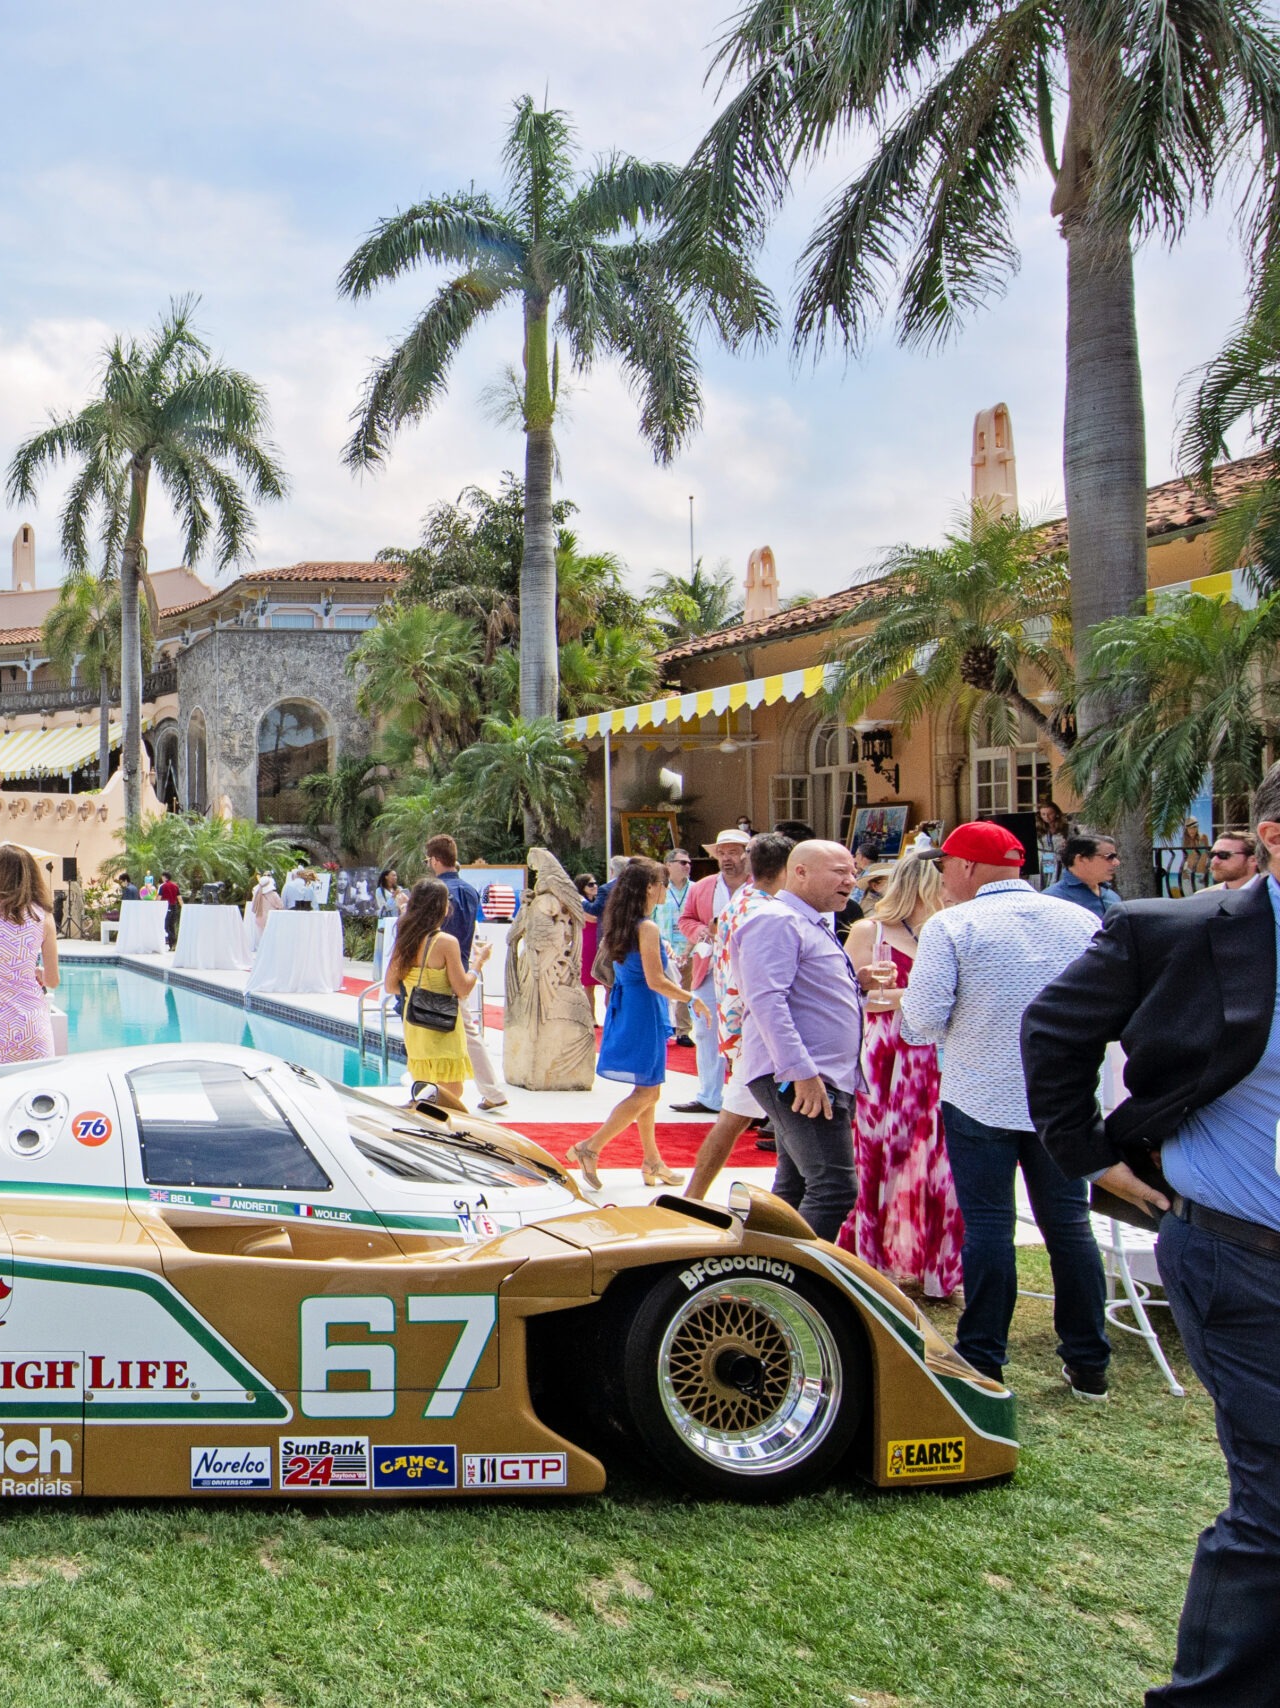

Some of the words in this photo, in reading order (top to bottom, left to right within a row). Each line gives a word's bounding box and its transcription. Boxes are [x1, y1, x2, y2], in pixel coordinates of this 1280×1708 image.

[76, 1118, 107, 1139] 76
[170, 1194, 195, 1204] BELL
[232, 1200, 278, 1214] ANDRETTI
[315, 1209, 352, 1222] WOLLEK
[678, 1256, 796, 1291] BFGoodrich
[298, 1293, 498, 1420] 67
[88, 1356, 191, 1389] LIFE
[282, 1441, 366, 1455] SunBank
[905, 1441, 963, 1466] EARL'S
[194, 1449, 265, 1477] Norelco
[284, 1456, 335, 1486] 24
[380, 1455, 449, 1474] CAMEL
[407, 1467, 423, 1478] GT
[467, 1458, 476, 1483] IMSA
[500, 1459, 562, 1480] GTP
[1, 1477, 72, 1496] Radials
